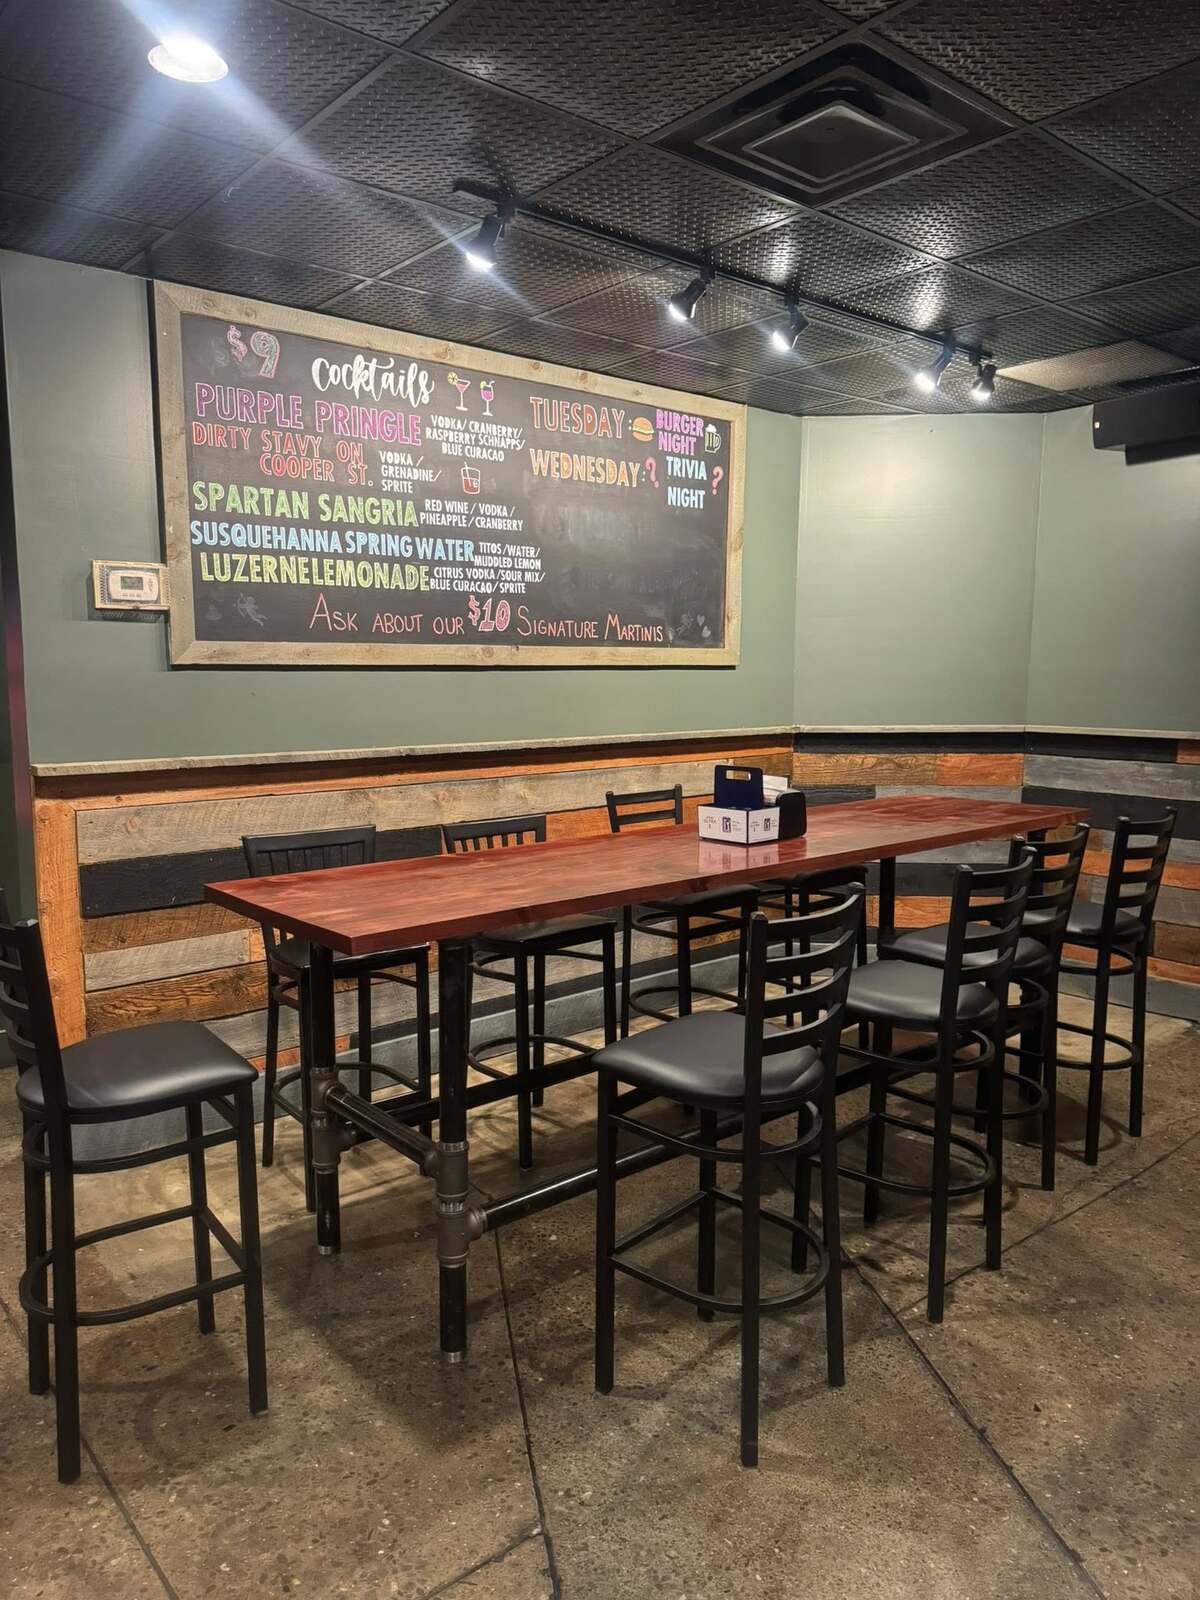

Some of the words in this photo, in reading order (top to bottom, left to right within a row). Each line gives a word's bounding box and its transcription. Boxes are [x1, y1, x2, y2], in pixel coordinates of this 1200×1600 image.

[226, 324, 281, 379] $9
[311, 354, 435, 408] Cocktails
[195, 382, 304, 430] PURPLE
[314, 400, 422, 446] PRINGLE
[655, 409, 705, 438] BURGER
[191, 421, 251, 450] DIRTY
[261, 430, 323, 458] STAVY
[335, 440, 364, 465] ON
[425, 427, 479, 444] RASPBERRY
[657, 430, 697, 456] NIGHT
[441, 442, 464, 457] BLUE
[259, 453, 335, 482] COOPER
[348, 462, 374, 487] ST.
[665, 455, 708, 481] TRIVIA
[381, 480, 414, 494] SPRITE
[666, 486, 706, 510] NIGHT
[192, 480, 310, 520] SPARTAN
[318, 493, 419, 527] SANGRIA
[424, 498, 442, 512] RED
[444, 500, 469, 514] WINE
[190, 520, 343, 554] SUSQUEHANNA
[345, 530, 413, 558] SPRING
[414, 536, 475, 562] WATER
[479, 541, 501, 555] TITOS
[199, 551, 310, 584] LUZERNE
[311, 557, 430, 592] LEMONADE
[433, 567, 464, 579] CITRUS
[474, 554, 513, 569] MUDDLED
[514, 556, 542, 571] LEMON
[430, 578, 451, 591] BLUE
[500, 582, 526, 594] SPRITE
[372, 612, 424, 635] ABOUT
[432, 616, 465, 636] OUR
[467, 594, 511, 632] $10
